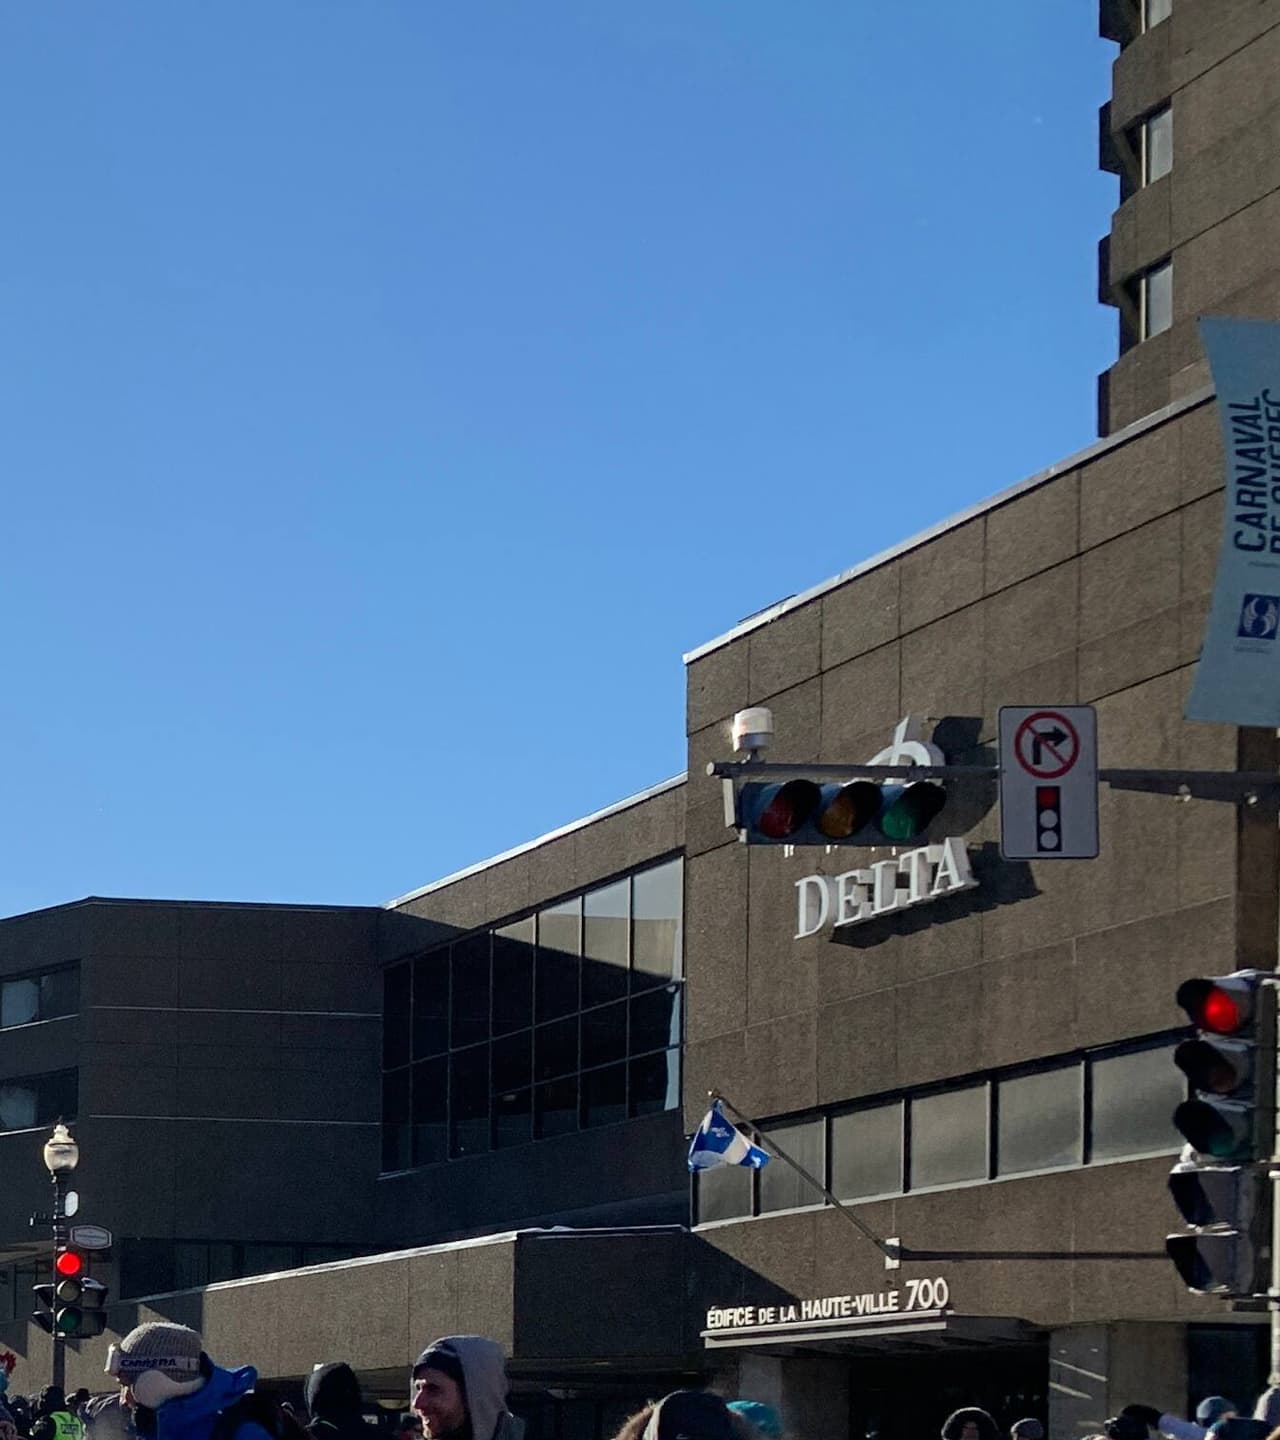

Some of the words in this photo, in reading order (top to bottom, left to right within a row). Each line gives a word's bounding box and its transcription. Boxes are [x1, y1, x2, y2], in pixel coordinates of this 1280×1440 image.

[1227, 396, 1268, 553] CARNAVAL
[794, 837, 980, 940] DELTA
[707, 1305, 753, 1329] ÉDIFICE
[757, 1307, 775, 1324] DE
[780, 1305, 797, 1322] LA
[801, 1290, 899, 1321] HAUTE-VILLE
[905, 1277, 950, 1310] 700
